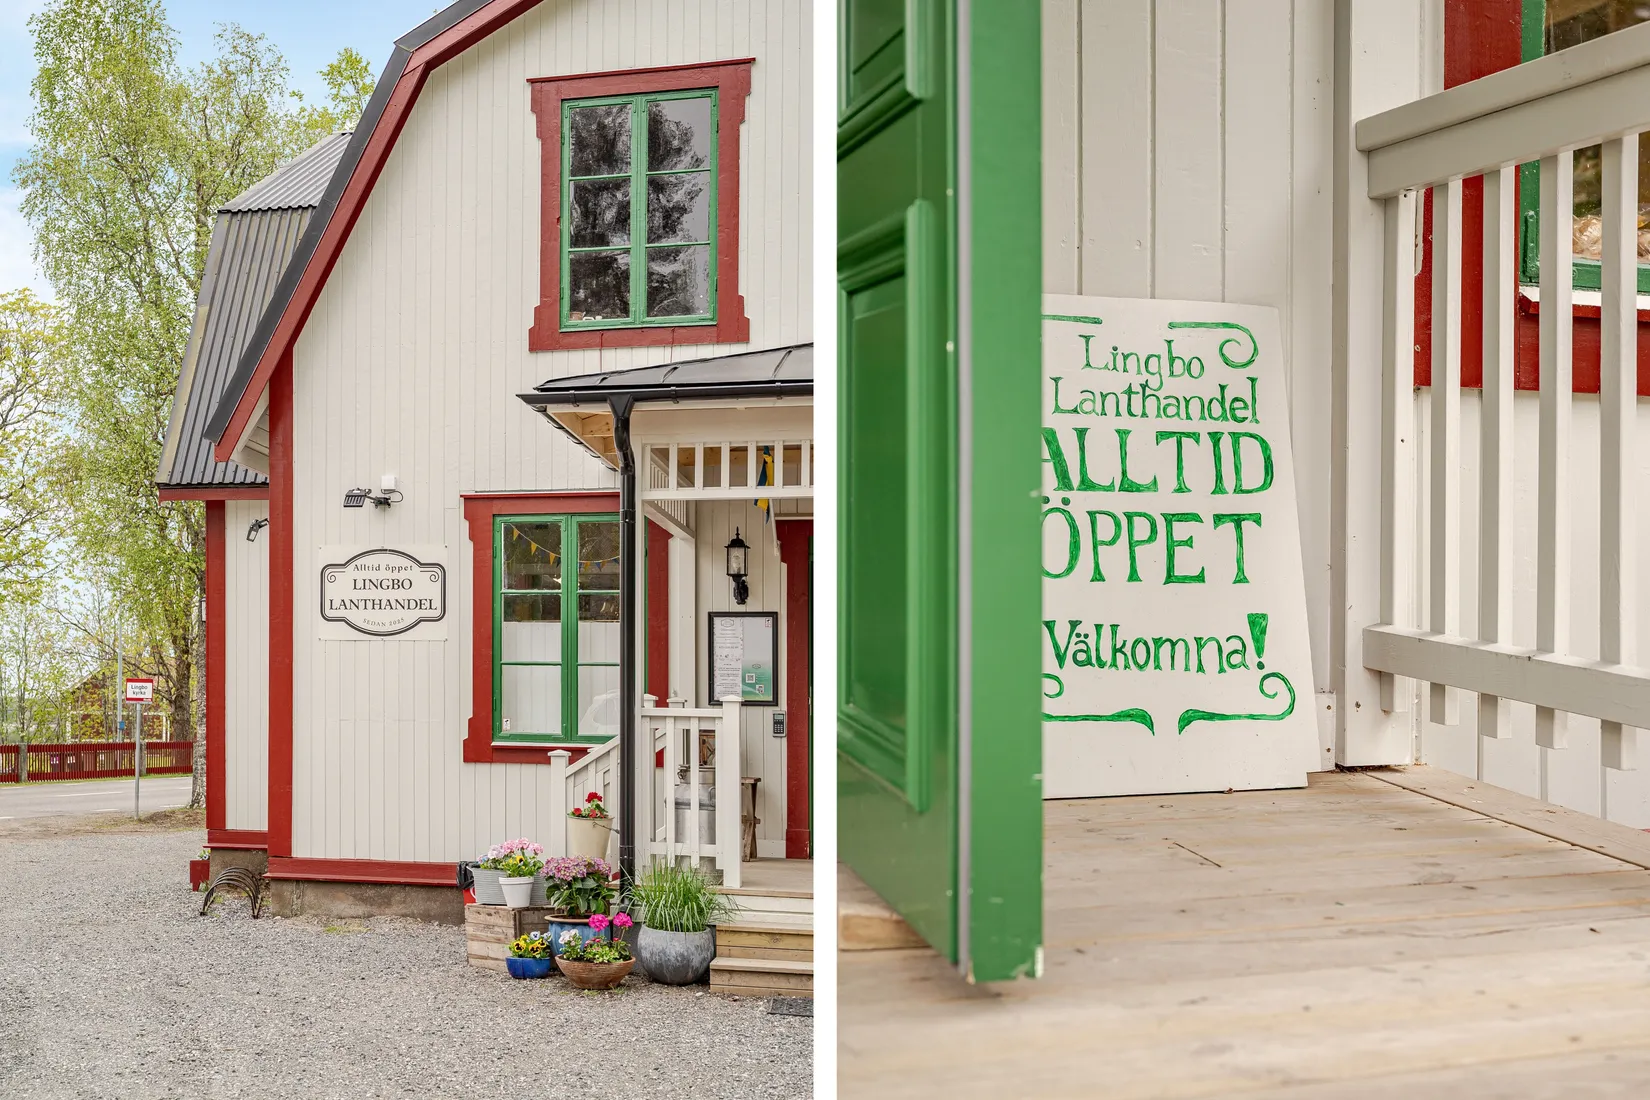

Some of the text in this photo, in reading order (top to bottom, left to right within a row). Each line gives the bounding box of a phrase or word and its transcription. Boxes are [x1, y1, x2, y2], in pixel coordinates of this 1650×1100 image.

[1078, 334, 1205, 392] Lingbo
[1049, 376, 1261, 425] Lanthandel
[1041, 495, 1263, 586] ÖPPET
[353, 564, 413, 573] Alltid öppet
[352, 578, 413, 591] LINGBO
[329, 598, 438, 611] LANTHANDEL
[363, 617, 405, 627] SEDAN 2025
[1042, 612, 1269, 675] Välkomna!
